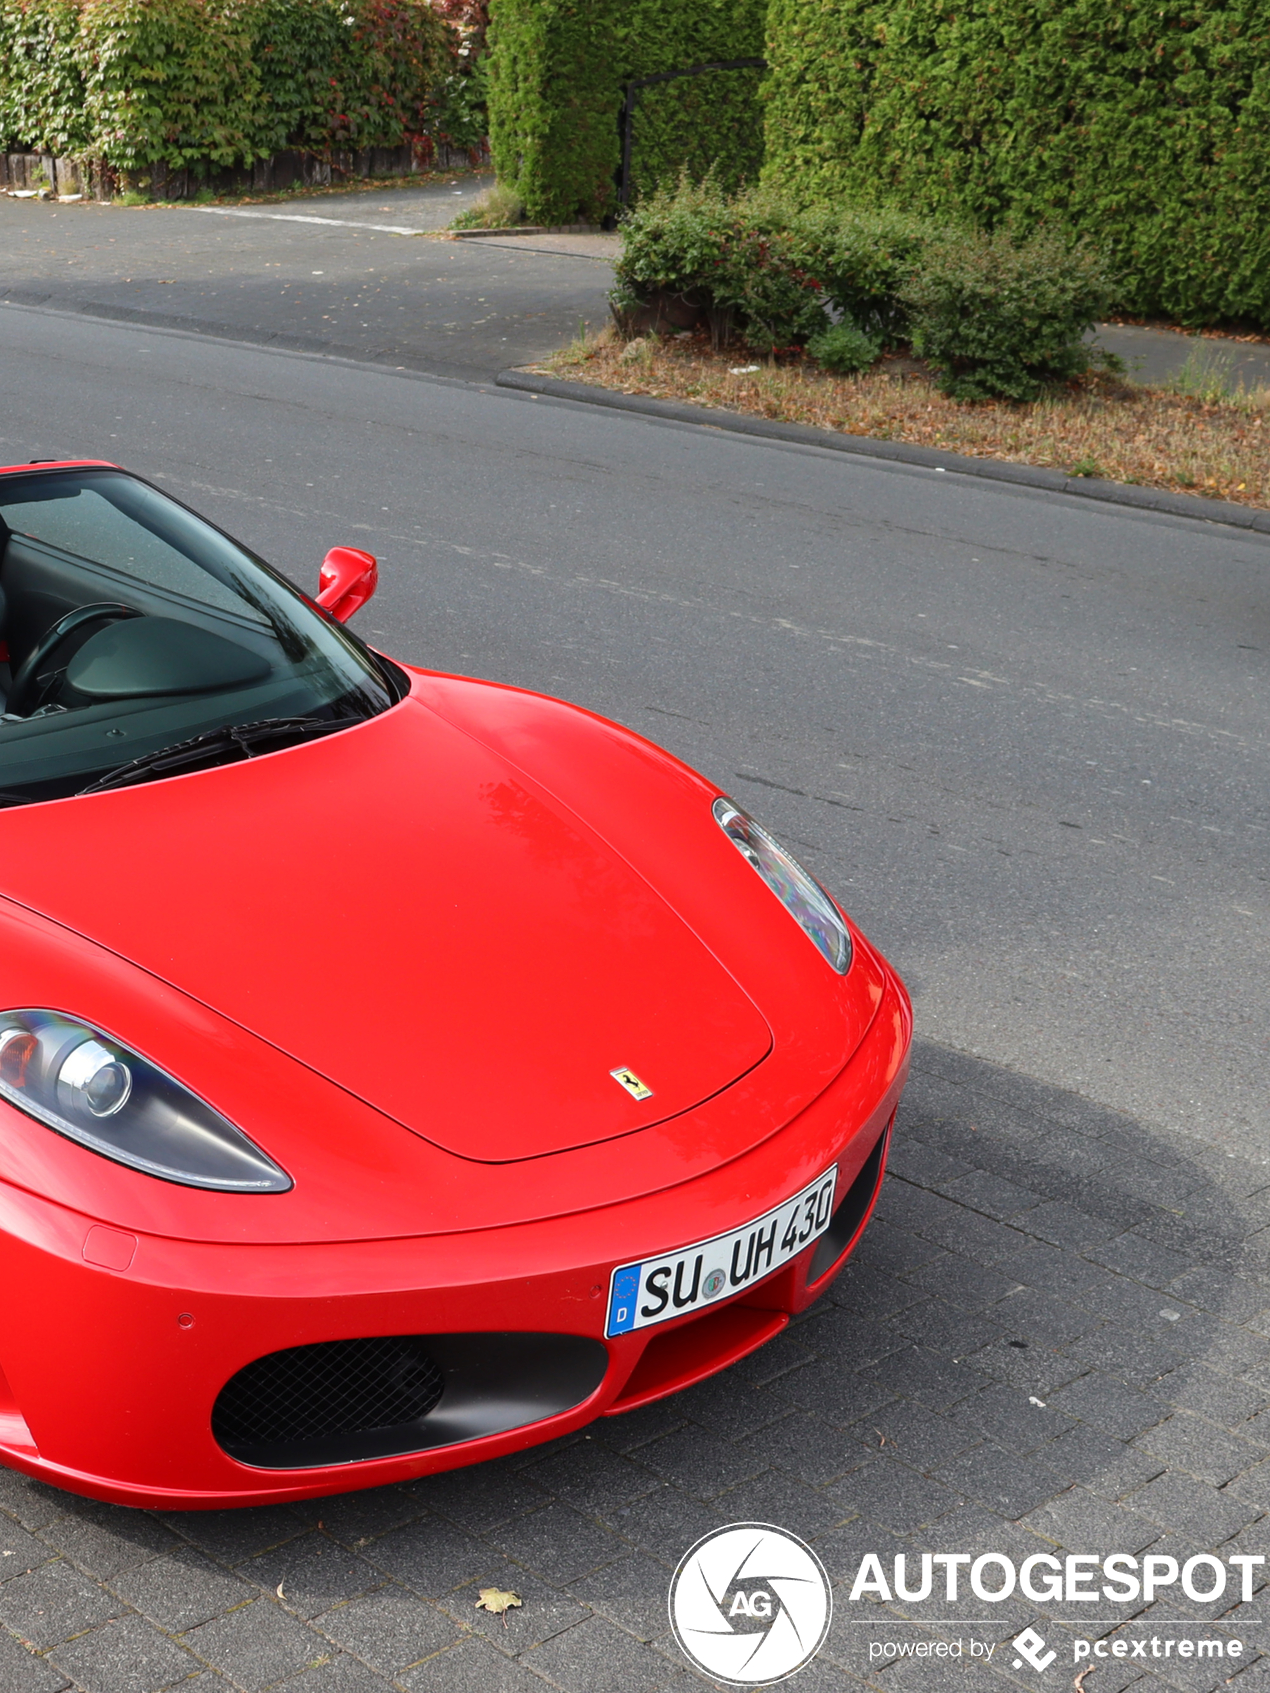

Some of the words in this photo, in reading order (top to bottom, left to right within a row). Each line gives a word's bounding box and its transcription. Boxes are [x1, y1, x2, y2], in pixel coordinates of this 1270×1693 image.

[641, 1254, 703, 1318] SU
[730, 1219, 778, 1287] UH
[781, 1178, 833, 1253] 430
[616, 1307, 628, 1323] D
